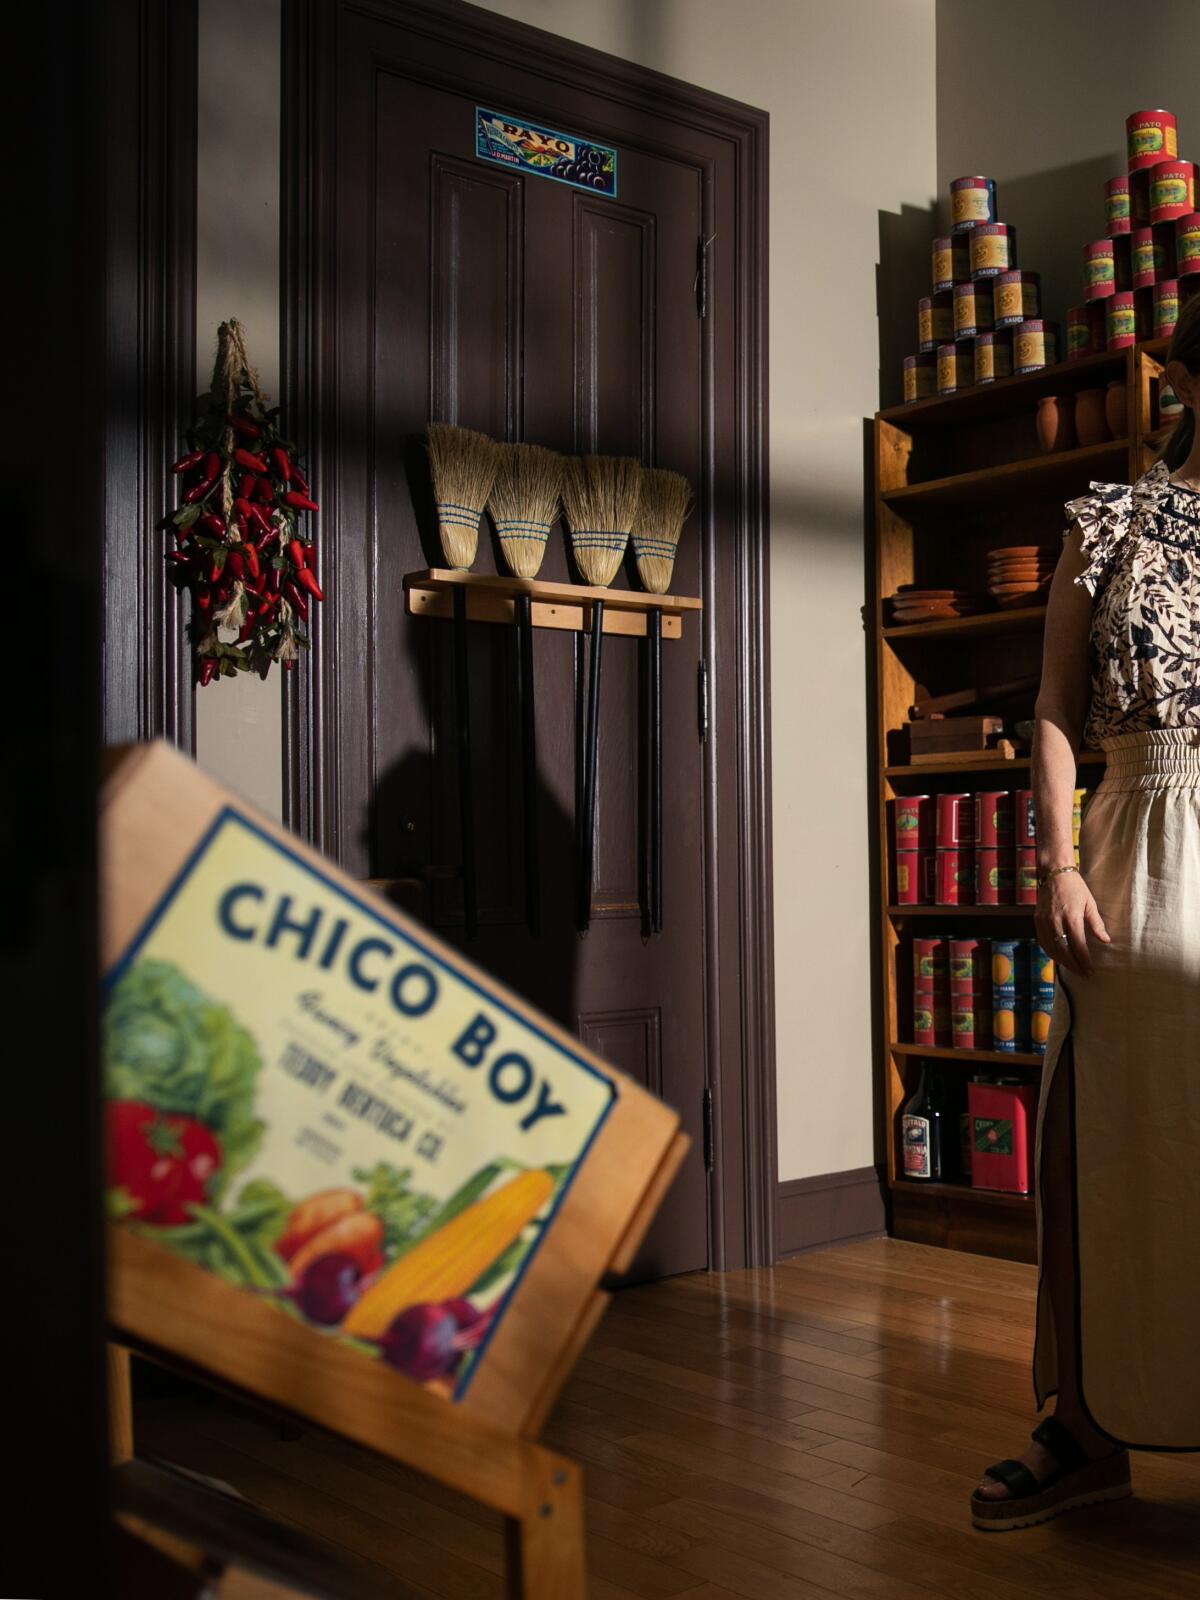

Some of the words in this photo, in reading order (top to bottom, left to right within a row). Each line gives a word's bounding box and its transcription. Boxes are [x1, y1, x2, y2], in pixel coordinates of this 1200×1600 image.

[503, 123, 570, 153] RAYO
[1140, 121, 1162, 129] PATO
[216, 880, 440, 1021] CHICO
[450, 1012, 568, 1134] BOY
